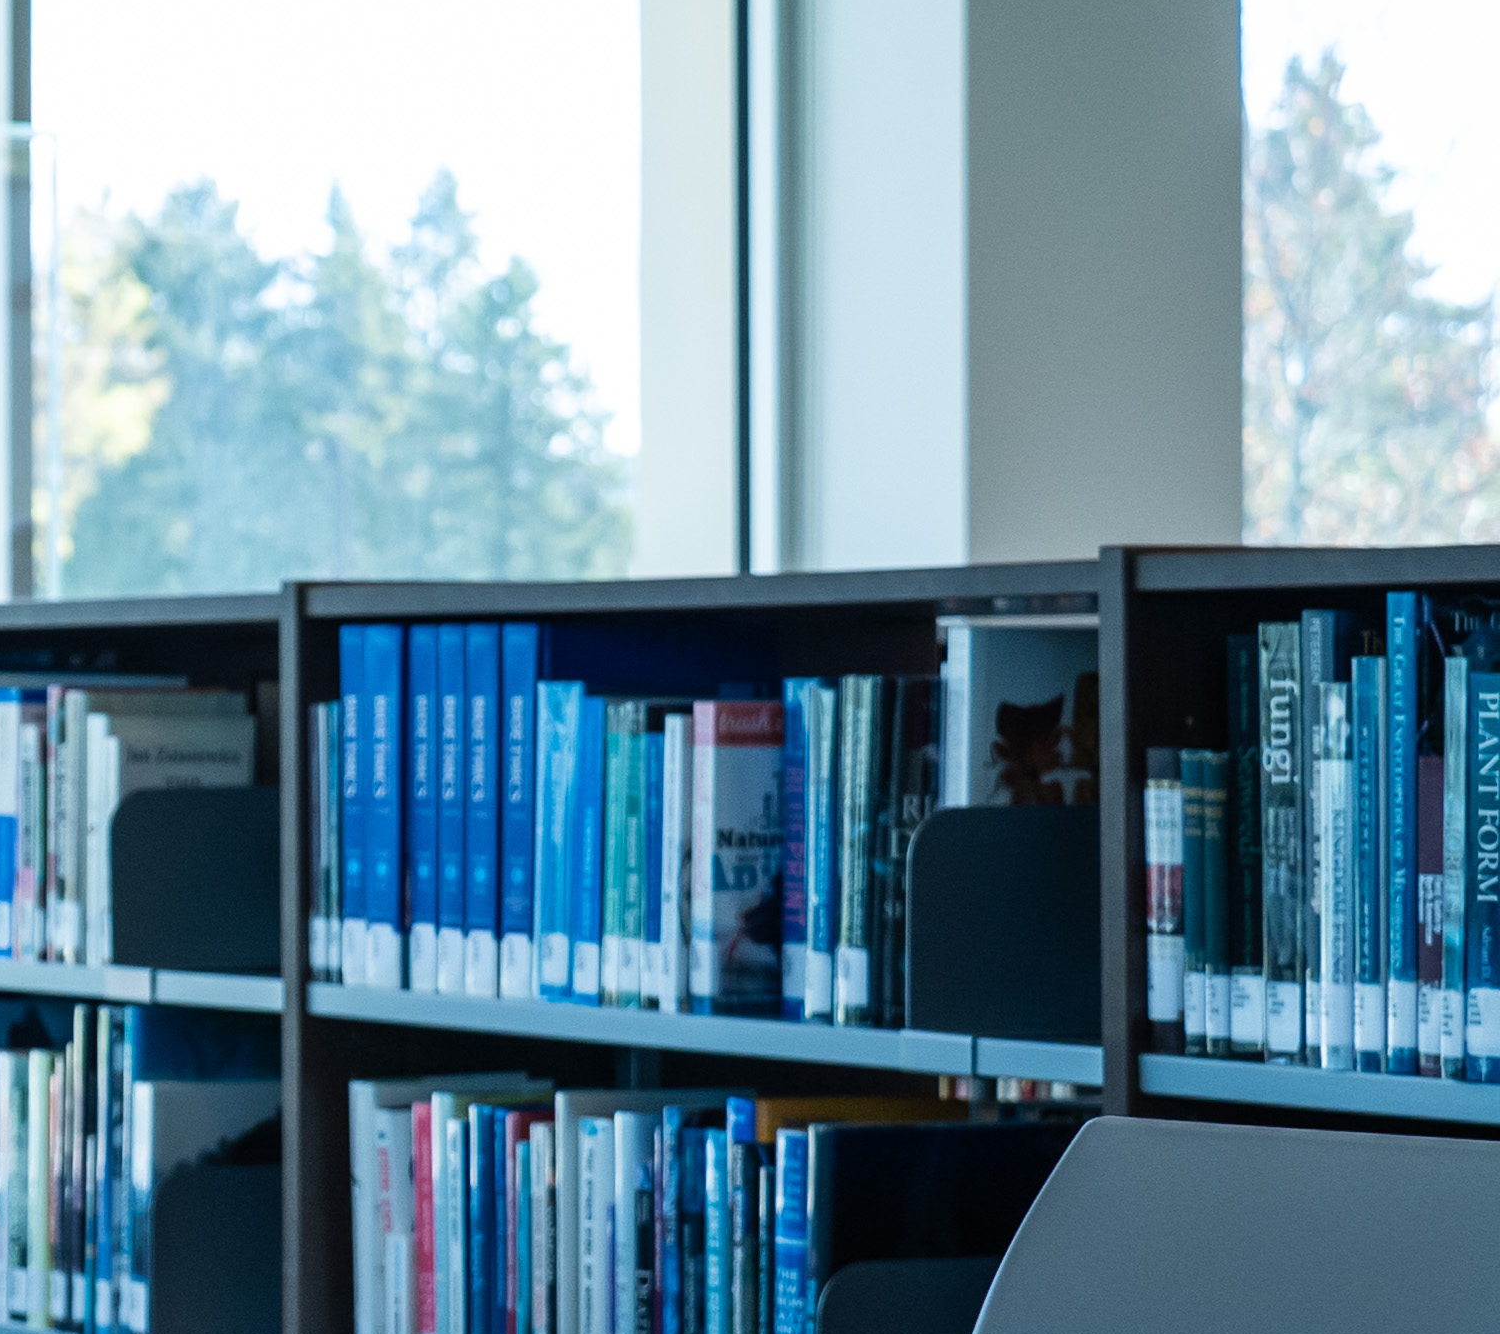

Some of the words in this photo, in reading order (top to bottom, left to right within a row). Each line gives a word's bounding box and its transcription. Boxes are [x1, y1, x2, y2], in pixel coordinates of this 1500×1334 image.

[1261, 677, 1299, 785] fungi
[1475, 691, 1500, 799] PLANT
[1475, 809, 1500, 903] FORM
